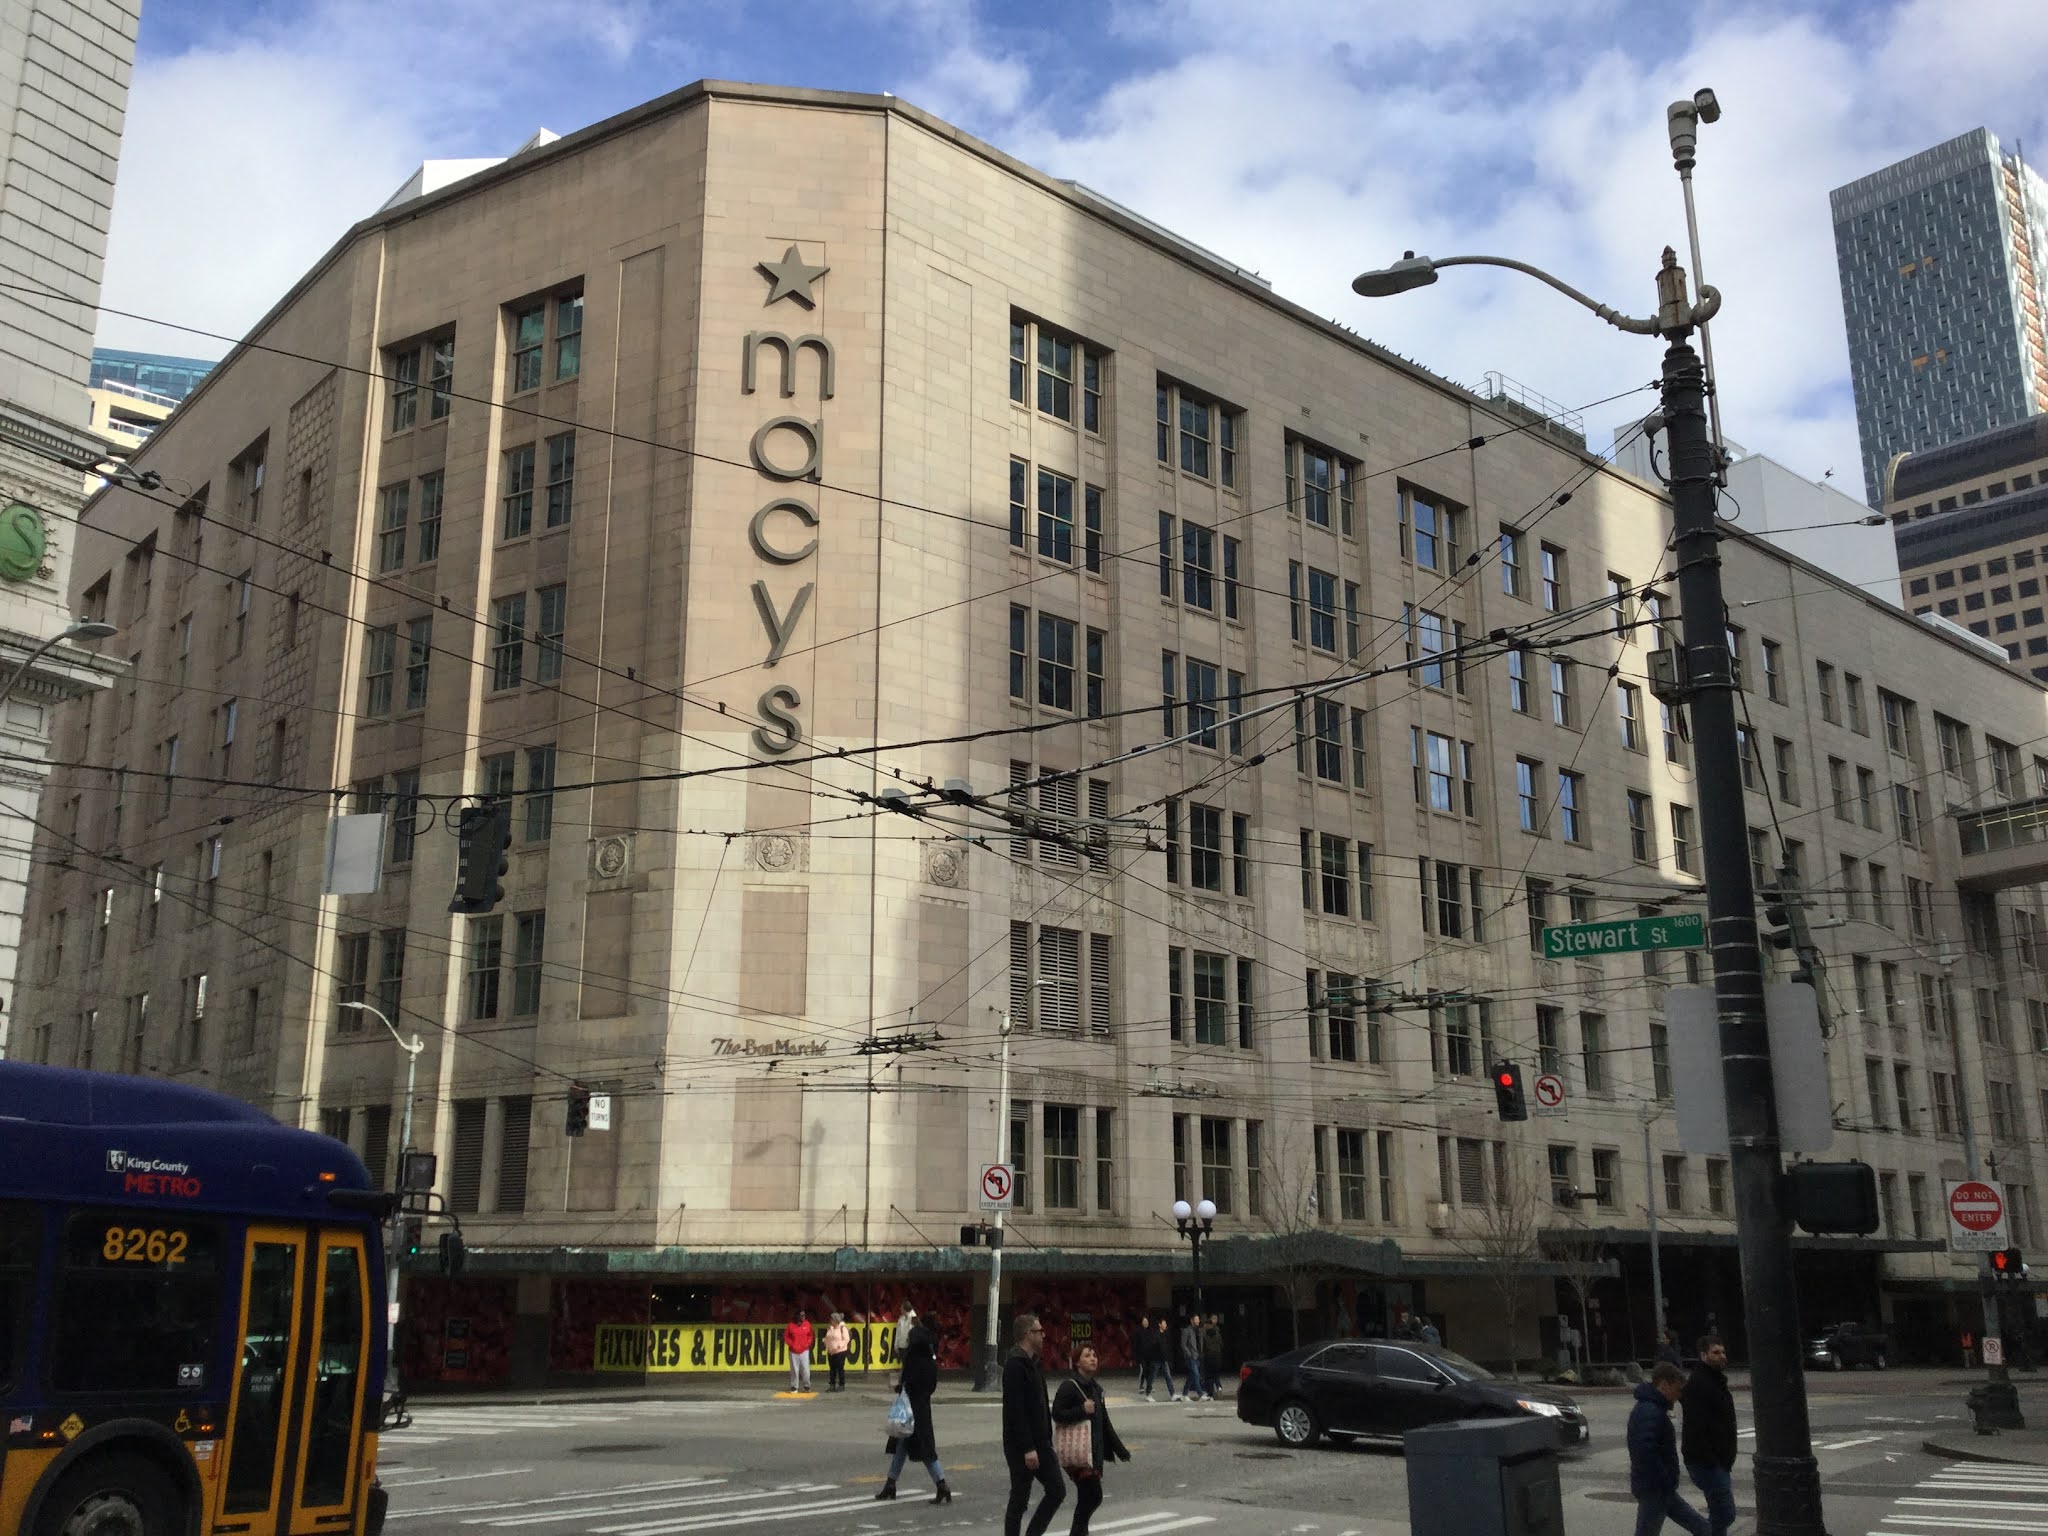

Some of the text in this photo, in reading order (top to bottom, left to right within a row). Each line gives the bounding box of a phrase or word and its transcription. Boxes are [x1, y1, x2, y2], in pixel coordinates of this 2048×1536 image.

[1673, 915, 1699, 928] 1600
[1551, 922, 1669, 953] Stewart St
[711, 1038, 741, 1055] The
[745, 1039, 774, 1056] Bon
[594, 1099, 606, 1109] NO
[591, 1112, 609, 1122] TURNS
[127, 1157, 189, 1175] King County
[124, 1173, 202, 1197] METRO
[1956, 1191, 1993, 1200] DO NOT
[1961, 1213, 1993, 1222] ENTER
[103, 1226, 188, 1263] 8262
[1071, 1323, 1092, 1338] HELD
[600, 1328, 681, 1367] FIXTURES
[690, 1328, 706, 1366] &
